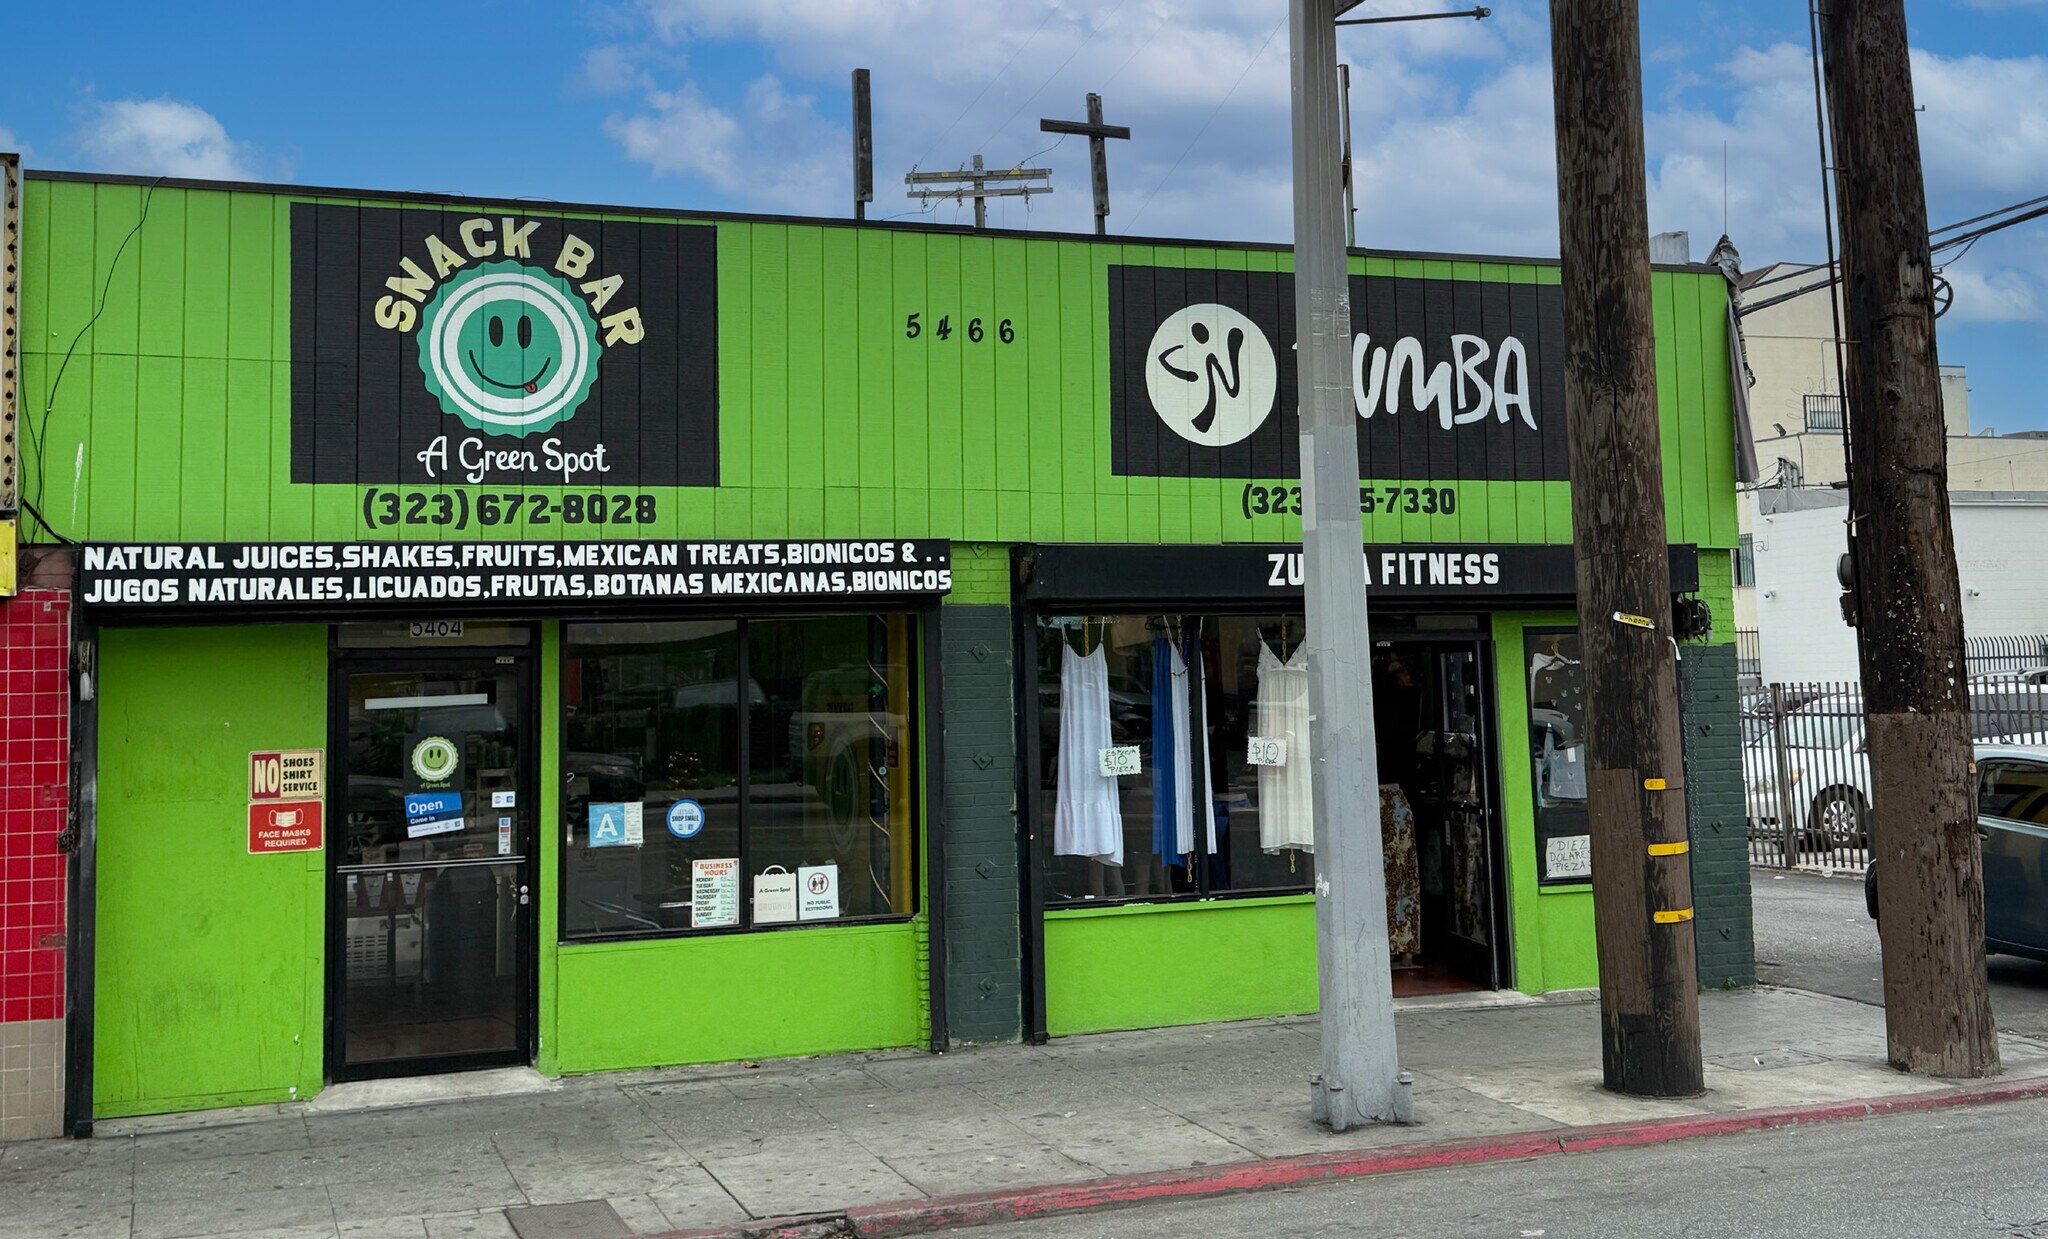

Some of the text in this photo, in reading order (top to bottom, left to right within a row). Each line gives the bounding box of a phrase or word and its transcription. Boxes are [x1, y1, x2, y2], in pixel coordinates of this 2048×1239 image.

[374, 217, 645, 348] SNACK BAR
[906, 312, 1015, 344] 5466
[1292, 332, 1538, 430] UMBA
[416, 435, 611, 484] A Green Spot
[84, 545, 225, 570] NATURAL
[901, 543, 918, 563] &
[1381, 552, 1500, 585] FITNESS
[84, 578, 180, 603] JUGOS
[1251, 742, 1279, 761] $10
[283, 757, 315, 768] SHOES
[254, 758, 280, 794] NO
[283, 770, 313, 780] SHIRT
[283, 782, 318, 792] SERVICE
[408, 800, 444, 815] Open
[410, 816, 428, 824] Come
[595, 812, 618, 838] A
[258, 828, 312, 839] FACE MASKS
[264, 839, 308, 848] REQUIRED
[1556, 839, 1588, 851] DIEZ
[700, 862, 733, 870] BUSINESS
[1552, 860, 1586, 872] PIEZA
